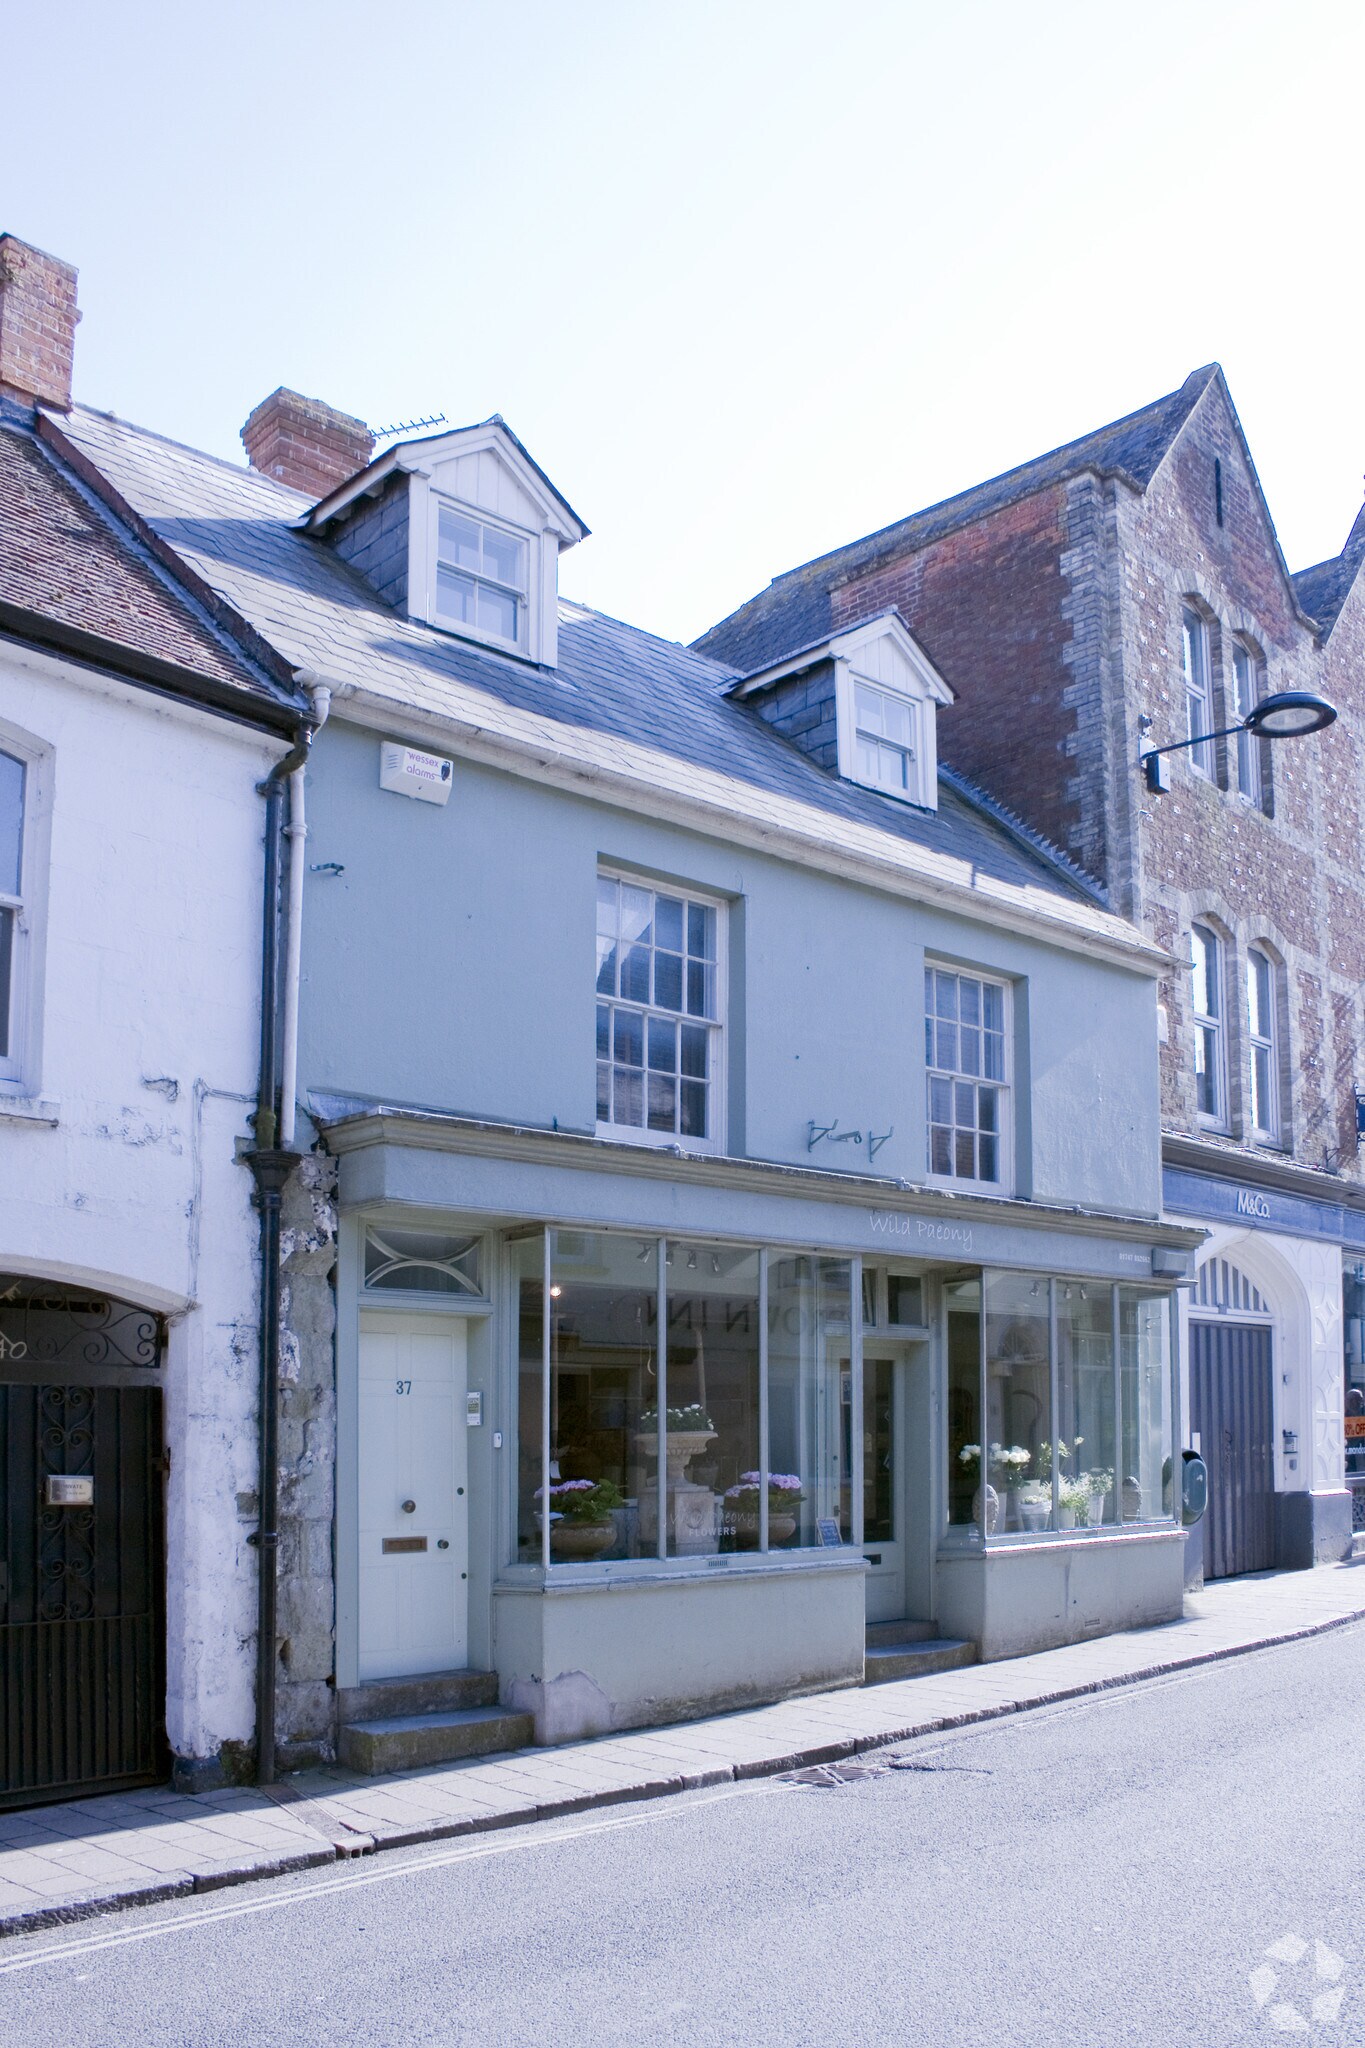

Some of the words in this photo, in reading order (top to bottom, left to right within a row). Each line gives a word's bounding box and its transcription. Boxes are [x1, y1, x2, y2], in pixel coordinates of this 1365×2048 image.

[407, 752, 438, 768] wessex
[406, 764, 435, 780] alarms
[1237, 1190, 1271, 1219] M&Co.
[869, 1214, 911, 1235] Wild
[916, 1220, 972, 1252] Paeony
[396, 1380, 412, 1395] 37
[689, 1526, 737, 1537] FLOWERS
